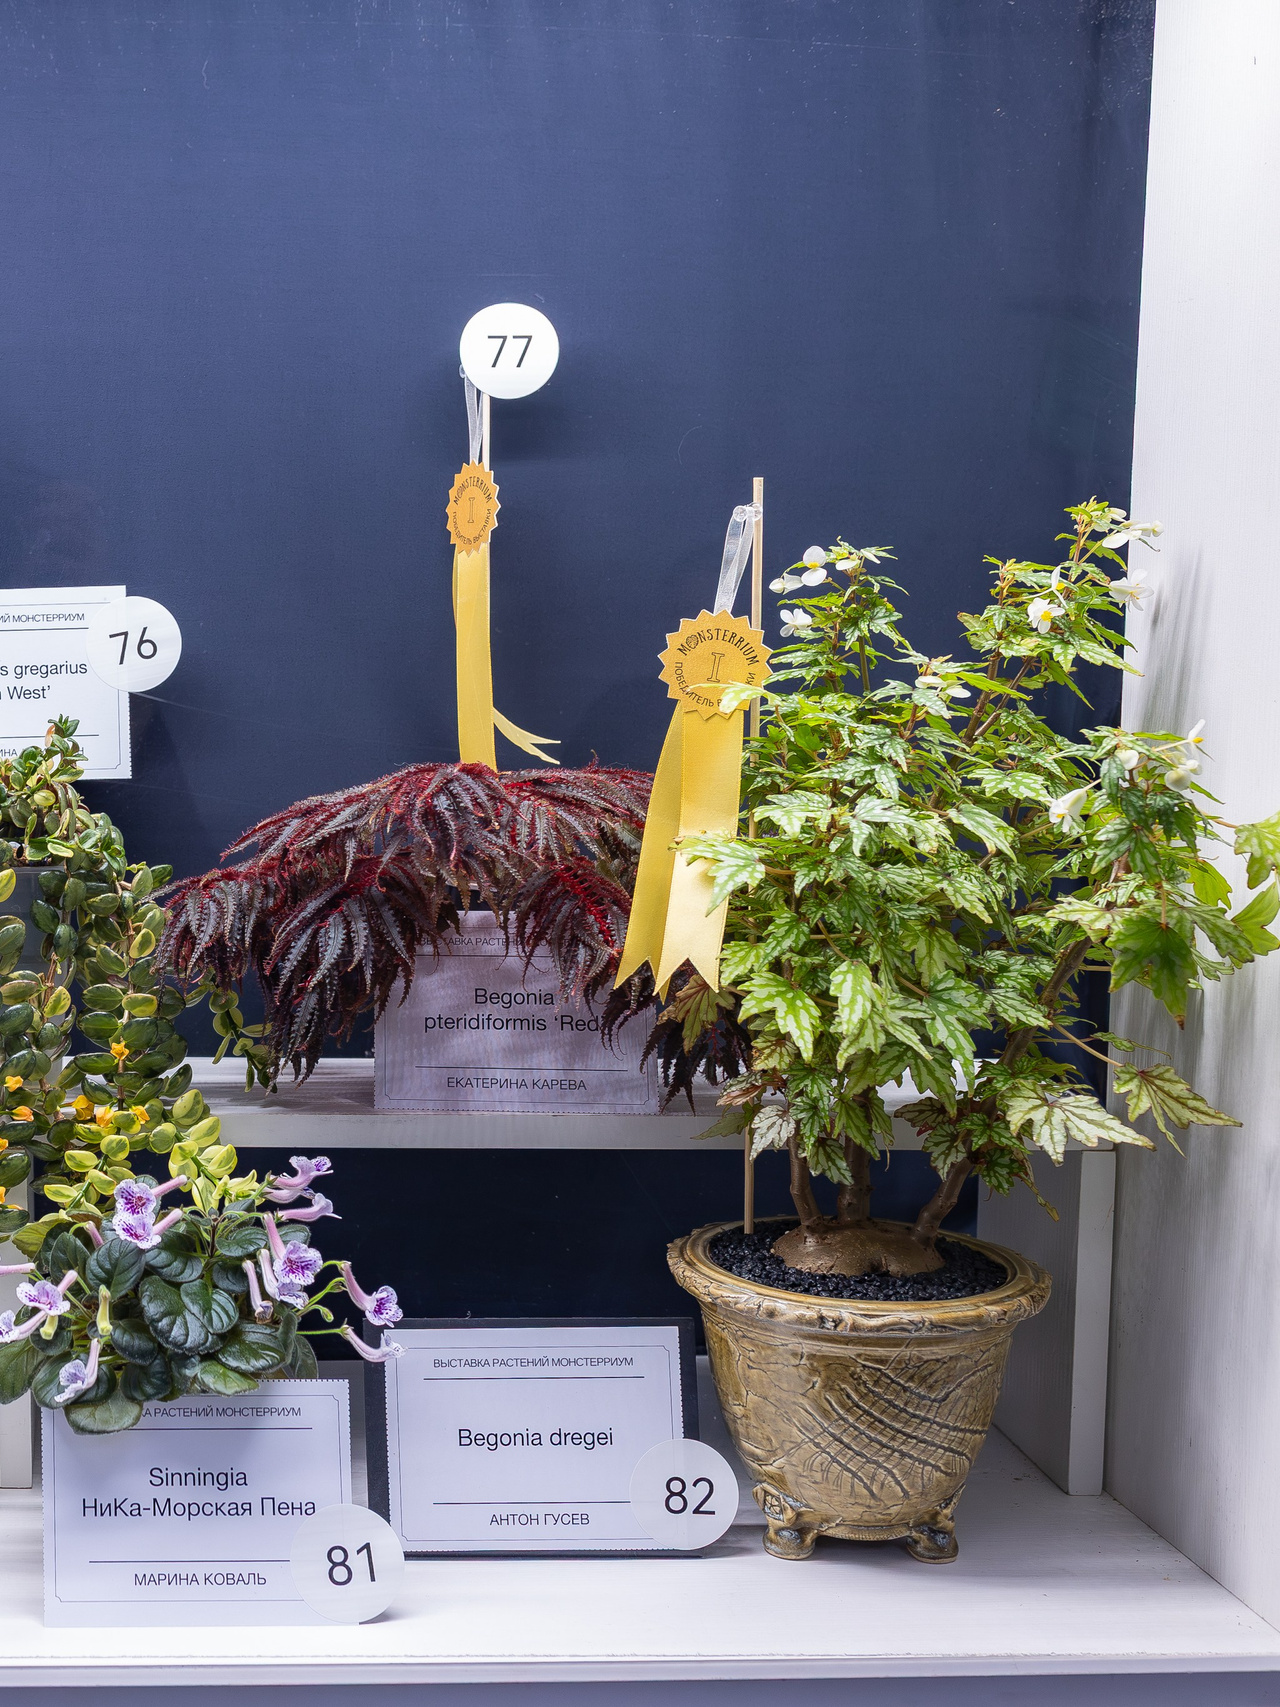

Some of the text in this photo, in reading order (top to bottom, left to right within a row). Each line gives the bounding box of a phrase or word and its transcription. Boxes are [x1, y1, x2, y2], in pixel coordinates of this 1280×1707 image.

[487, 335, 533, 368] 77
[12, 613, 85, 624] МОНСТЕРРИУМ
[108, 626, 158, 666] 76
[14, 660, 88, 680] gregarius
[7, 685, 51, 701] West’
[674, 661, 714, 707] ПОБЕДИТЕЛЬ
[474, 987, 555, 1008] Begonia
[424, 1014, 547, 1034] pteridiformis
[446, 1077, 587, 1091] ЕКАТЕРИНА КАРЕВА
[433, 1355, 634, 1368] ВЫСТАВКА РАСТЕНИЙ МОНСТЕРРИУМ
[154, 1405, 214, 1417] РАСТЕНИЙ
[216, 1407, 302, 1417] МОНСТЕРРИУМ
[458, 1427, 614, 1451] Begonia dregei
[149, 1467, 248, 1491] Sinningia
[664, 1476, 716, 1515] 82
[82, 1497, 316, 1521] НиКа-Морская Пена
[489, 1513, 590, 1526] АНТОН ГУСЕВ
[326, 1542, 377, 1586] 81
[134, 1573, 267, 1586] МАРИНА КОВАЛЬ
